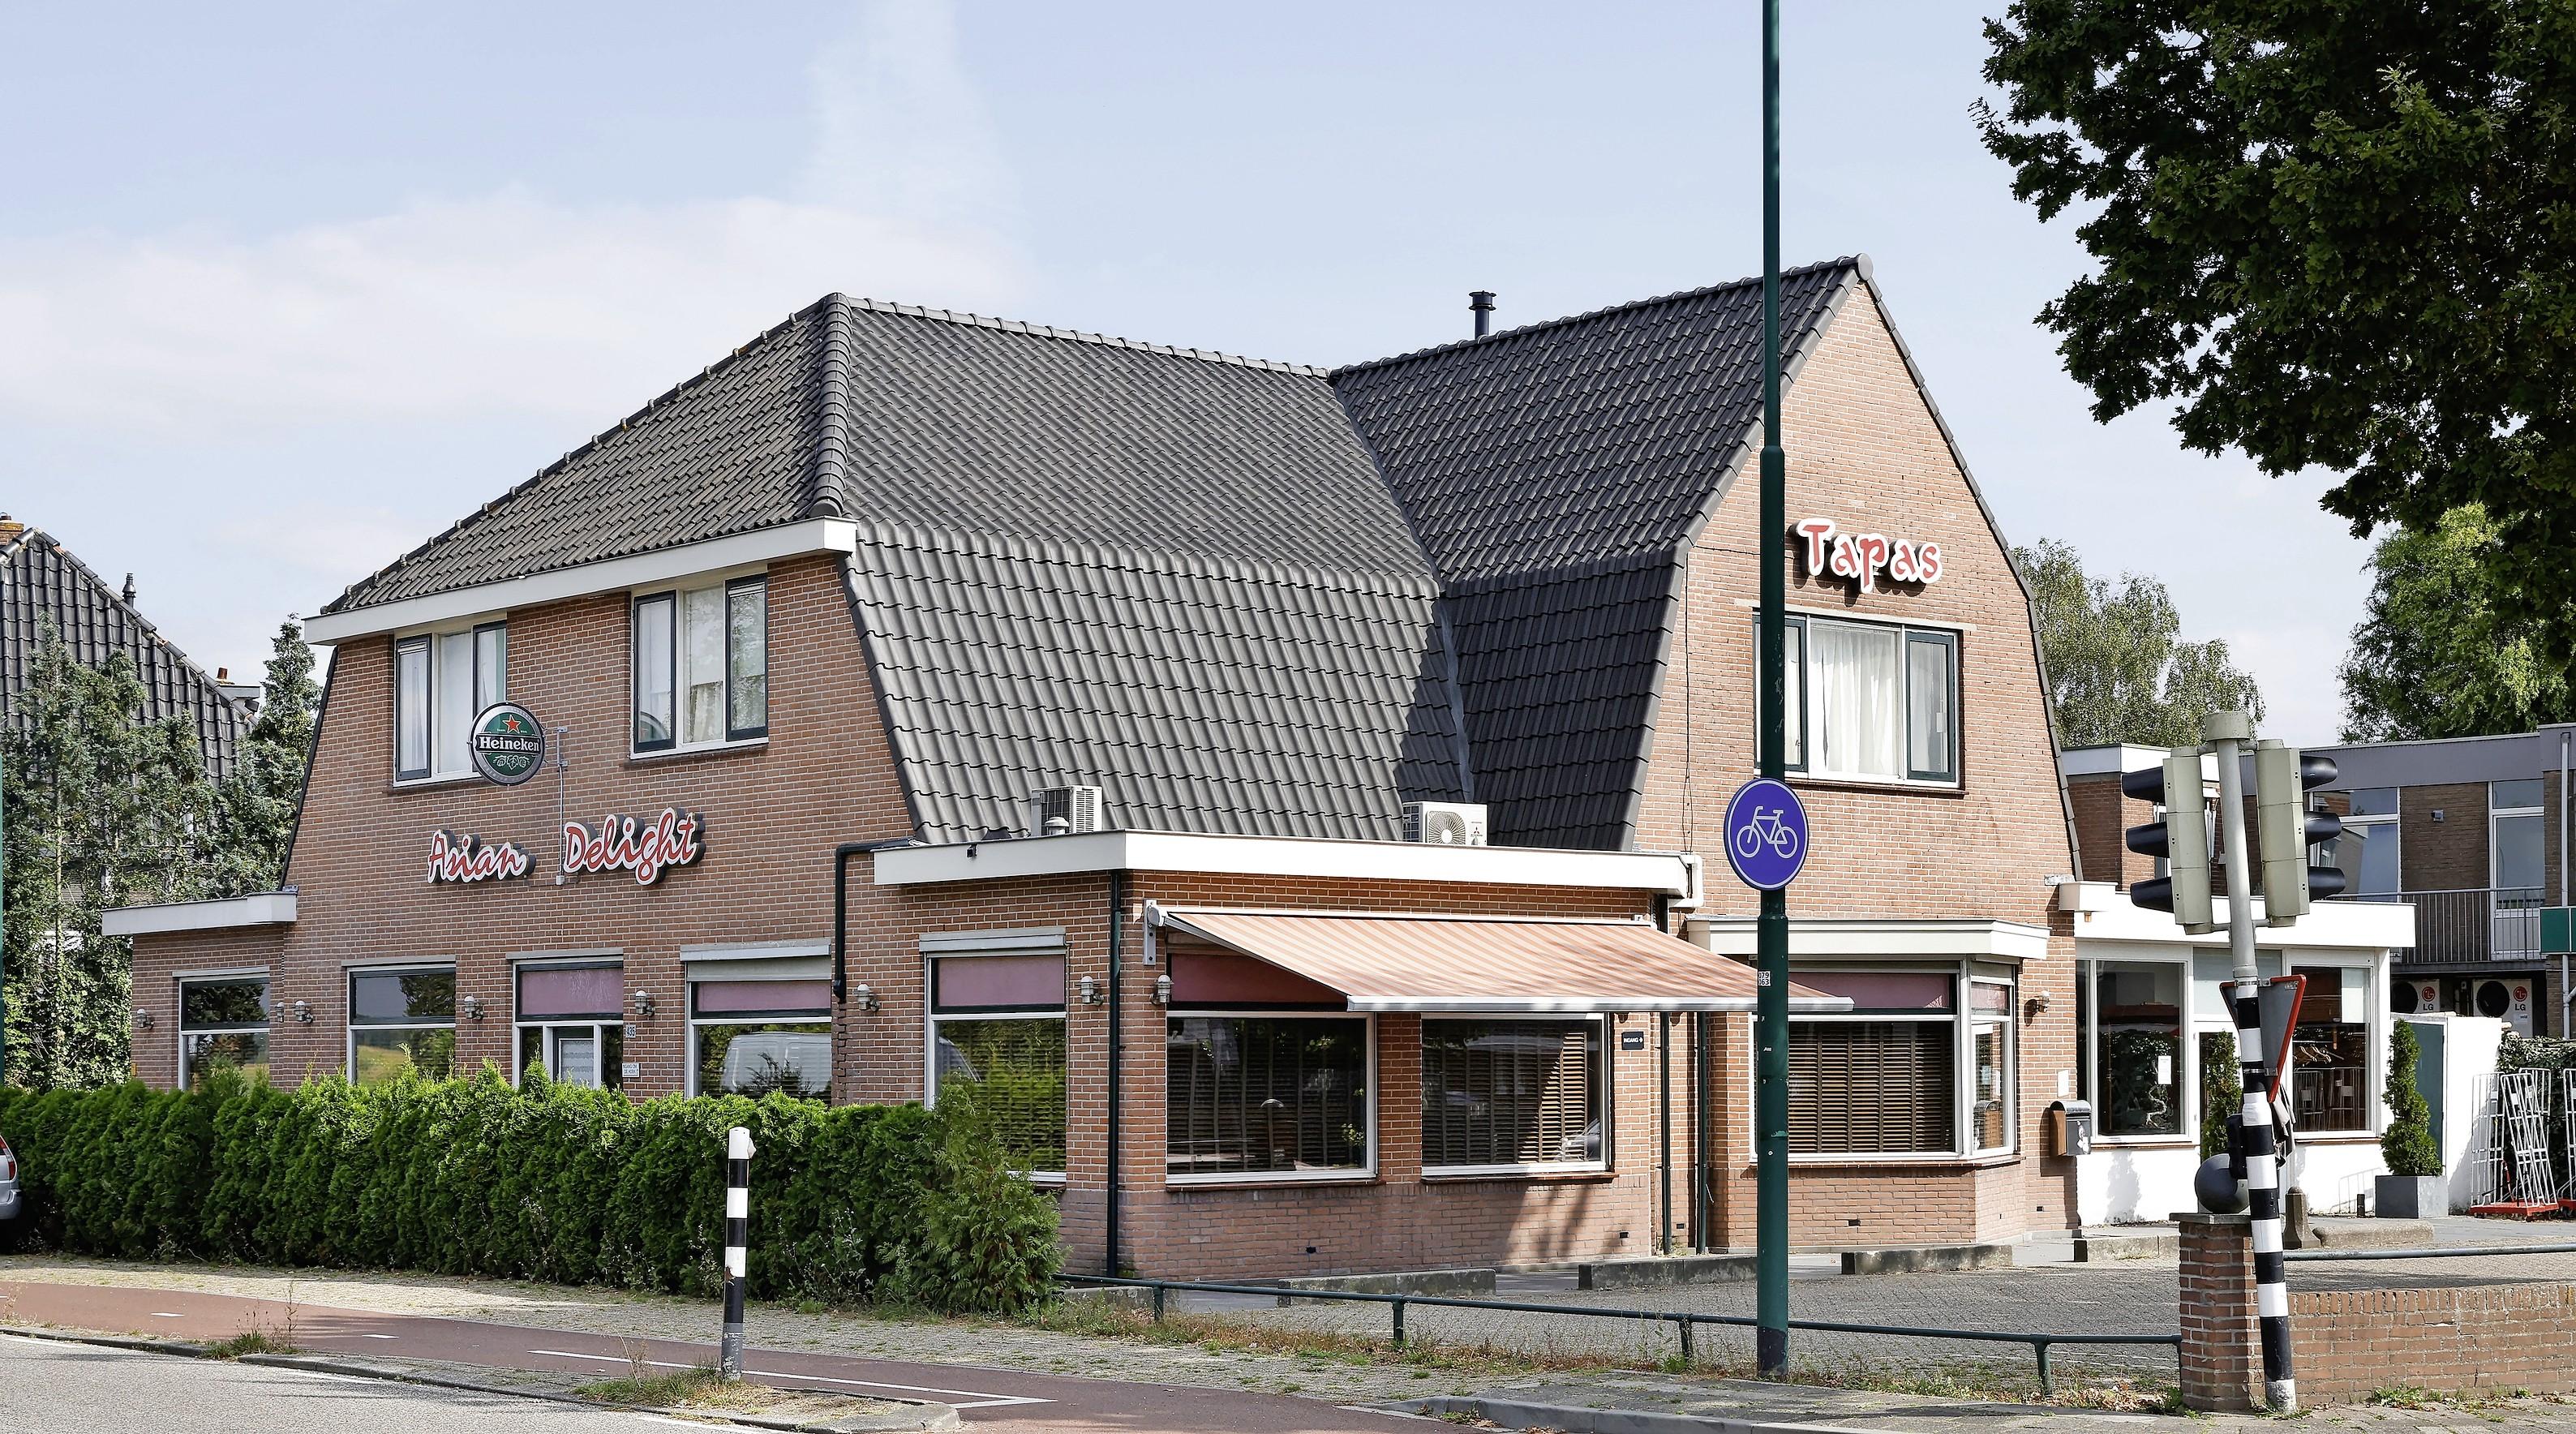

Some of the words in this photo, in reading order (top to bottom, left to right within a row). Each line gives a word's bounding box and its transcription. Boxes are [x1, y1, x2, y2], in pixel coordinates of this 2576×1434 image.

[1797, 517, 1943, 594] Tapas
[479, 736, 539, 752] Heineken
[428, 829, 528, 883] Asian
[564, 807, 697, 886] Delight
